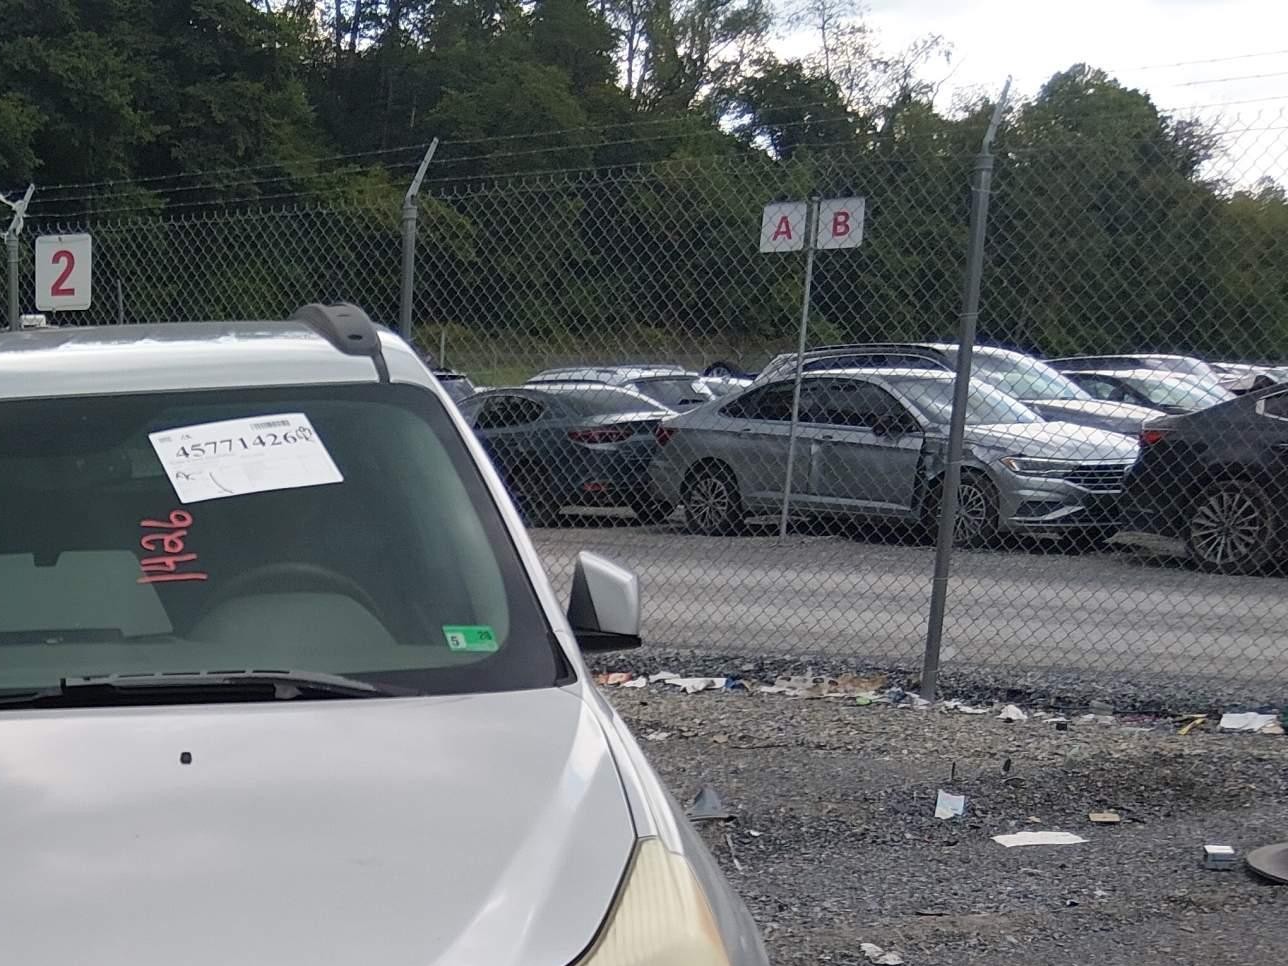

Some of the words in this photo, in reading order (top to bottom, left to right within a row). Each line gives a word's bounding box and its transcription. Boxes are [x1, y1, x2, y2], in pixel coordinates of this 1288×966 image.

[772, 215, 792, 241] A
[832, 211, 850, 237] B
[51, 249, 76, 297] 2
[175, 430, 298, 460] 45771426
[136, 509, 208, 584] 1426
[450, 635, 460, 647] 5
